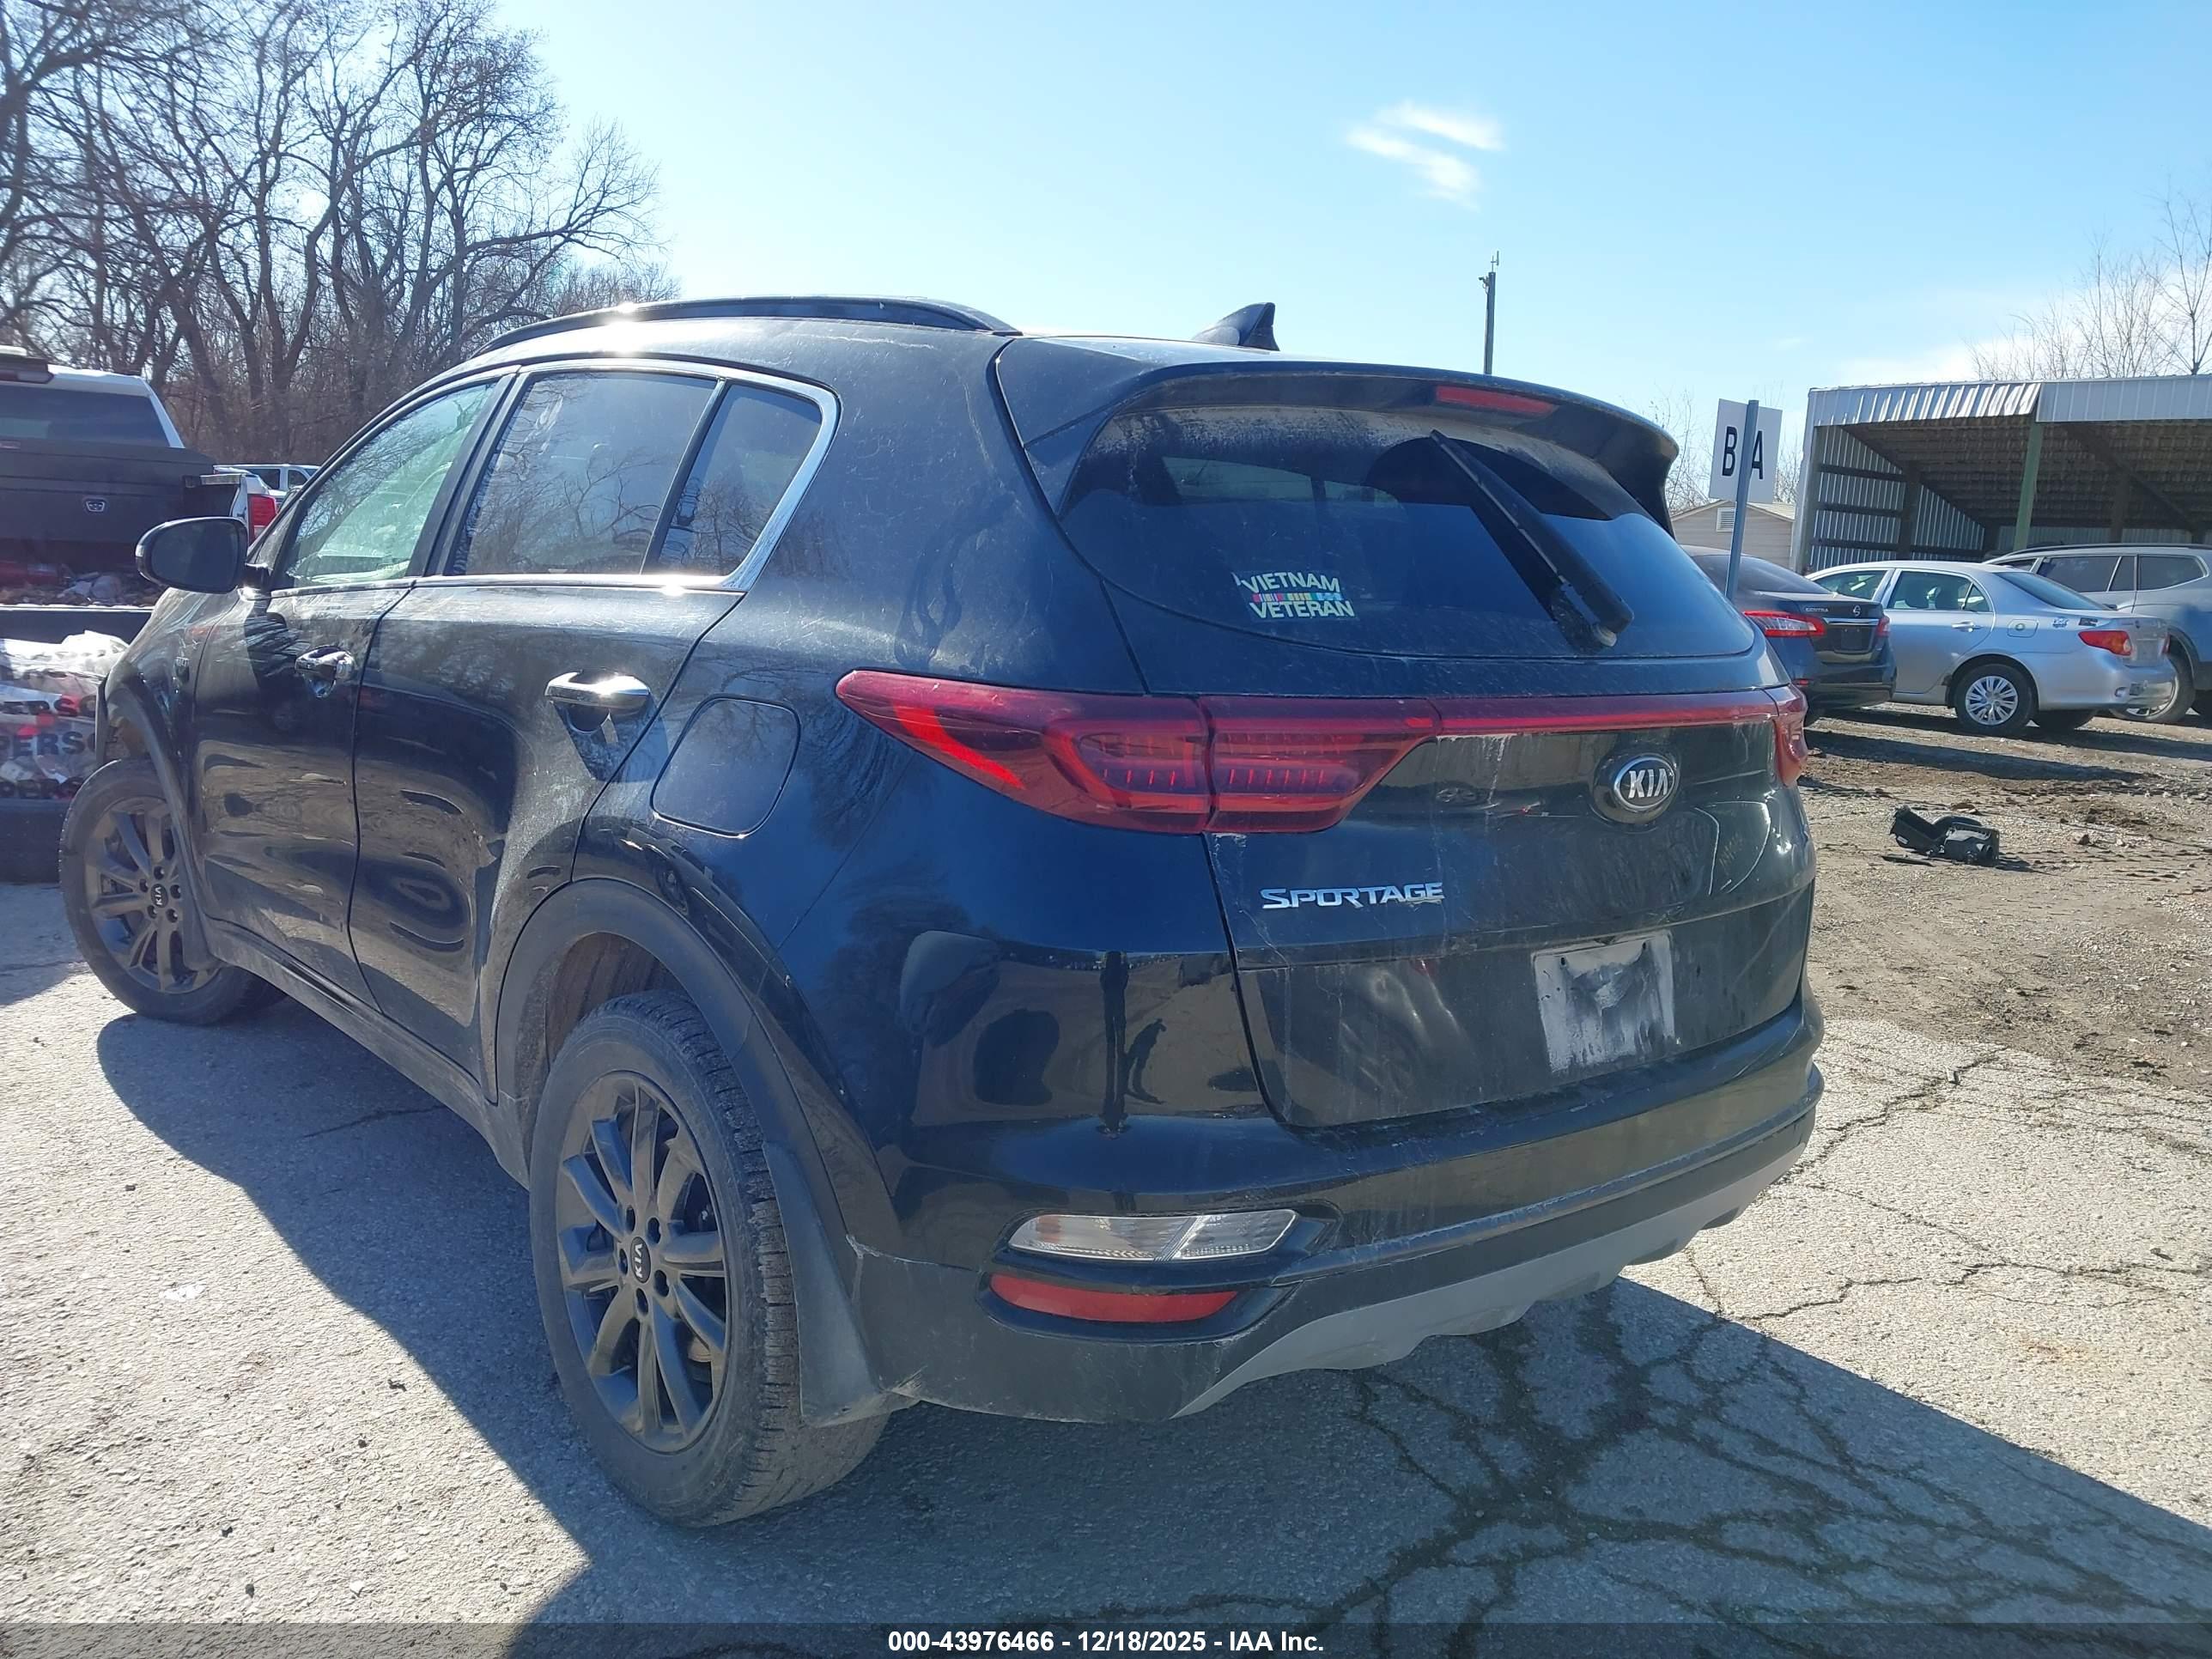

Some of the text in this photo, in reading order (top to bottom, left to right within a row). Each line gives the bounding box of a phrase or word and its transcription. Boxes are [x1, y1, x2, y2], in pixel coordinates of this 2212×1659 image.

[1722, 426, 1764, 480] B A
[1240, 572, 1341, 593] VIETNAM
[1249, 600, 1356, 619] VETERAN
[1628, 768, 1668, 799] KIA
[155, 886, 163, 906] KIA
[1260, 882, 1446, 909] SPORTAGE
[635, 1243, 643, 1279] KIA
